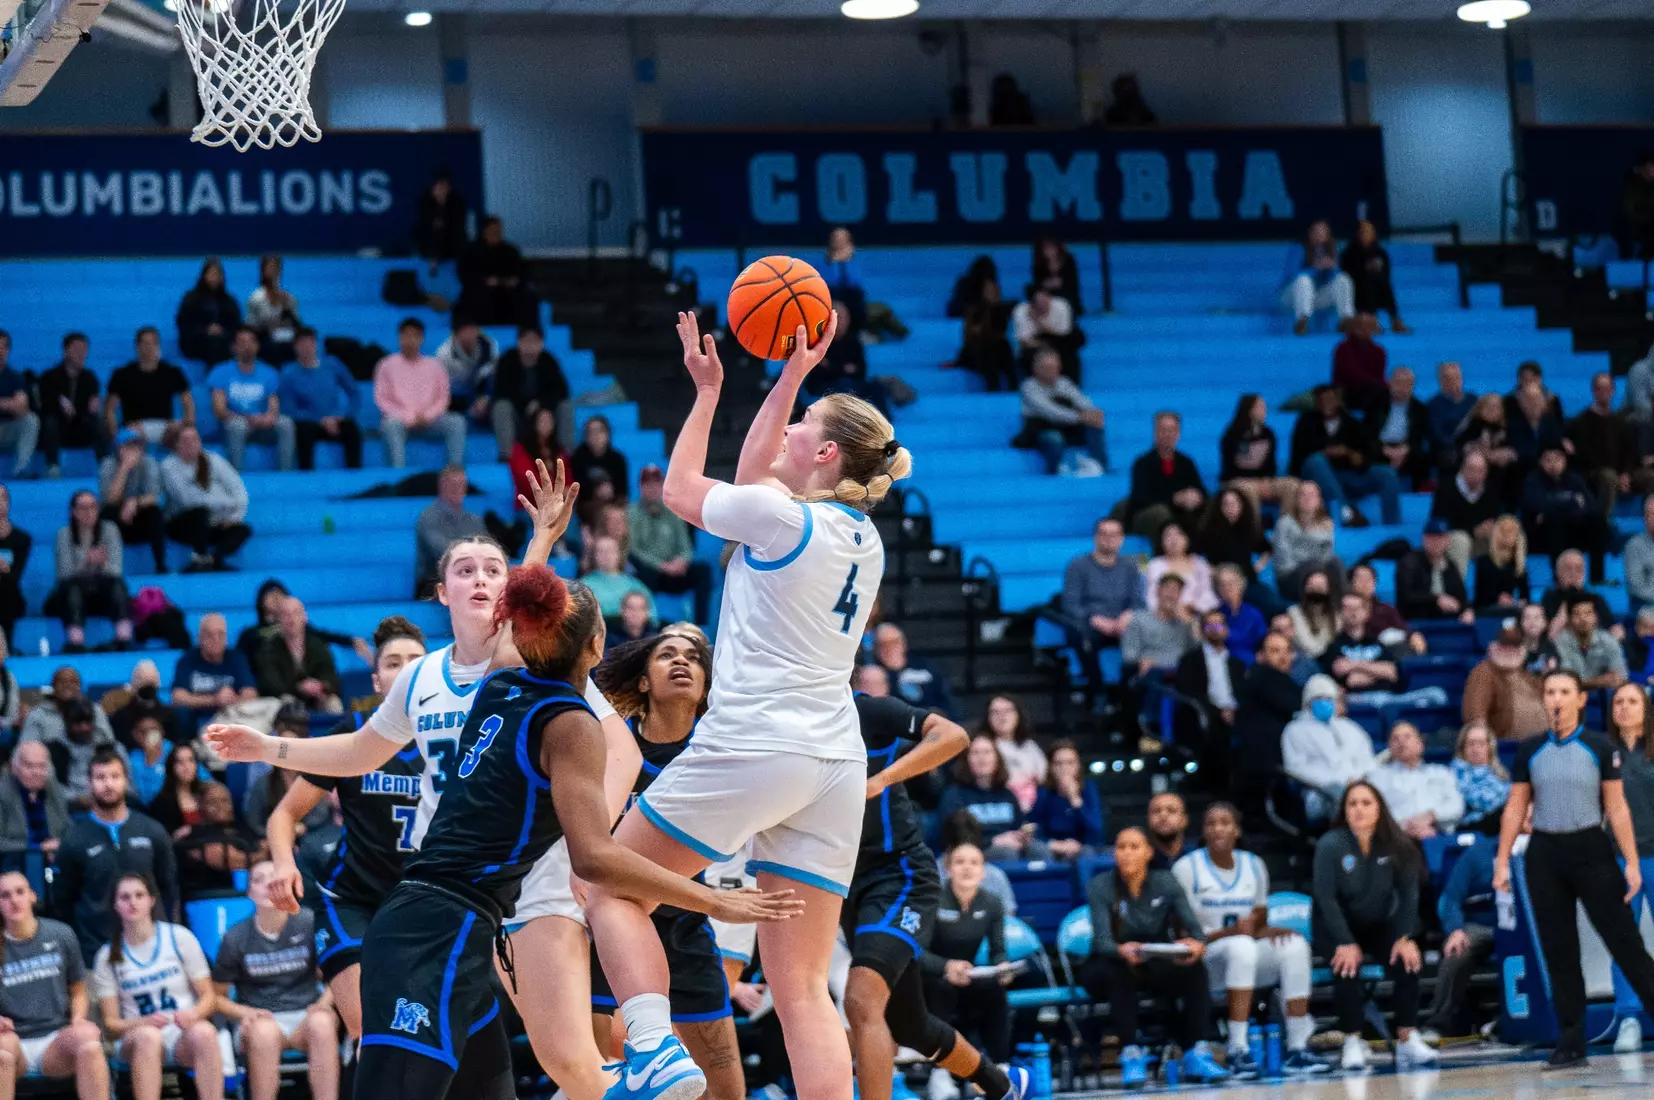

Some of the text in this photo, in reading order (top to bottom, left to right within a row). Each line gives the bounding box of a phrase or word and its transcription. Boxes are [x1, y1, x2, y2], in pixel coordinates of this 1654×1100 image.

[0, 170, 394, 217] LUMBIALIONS
[747, 151, 1295, 225] COLUMBIA
[832, 562, 858, 634] 4
[458, 714, 504, 779] 3
[392, 805, 419, 852] 7
[1503, 955, 1530, 1019] C
